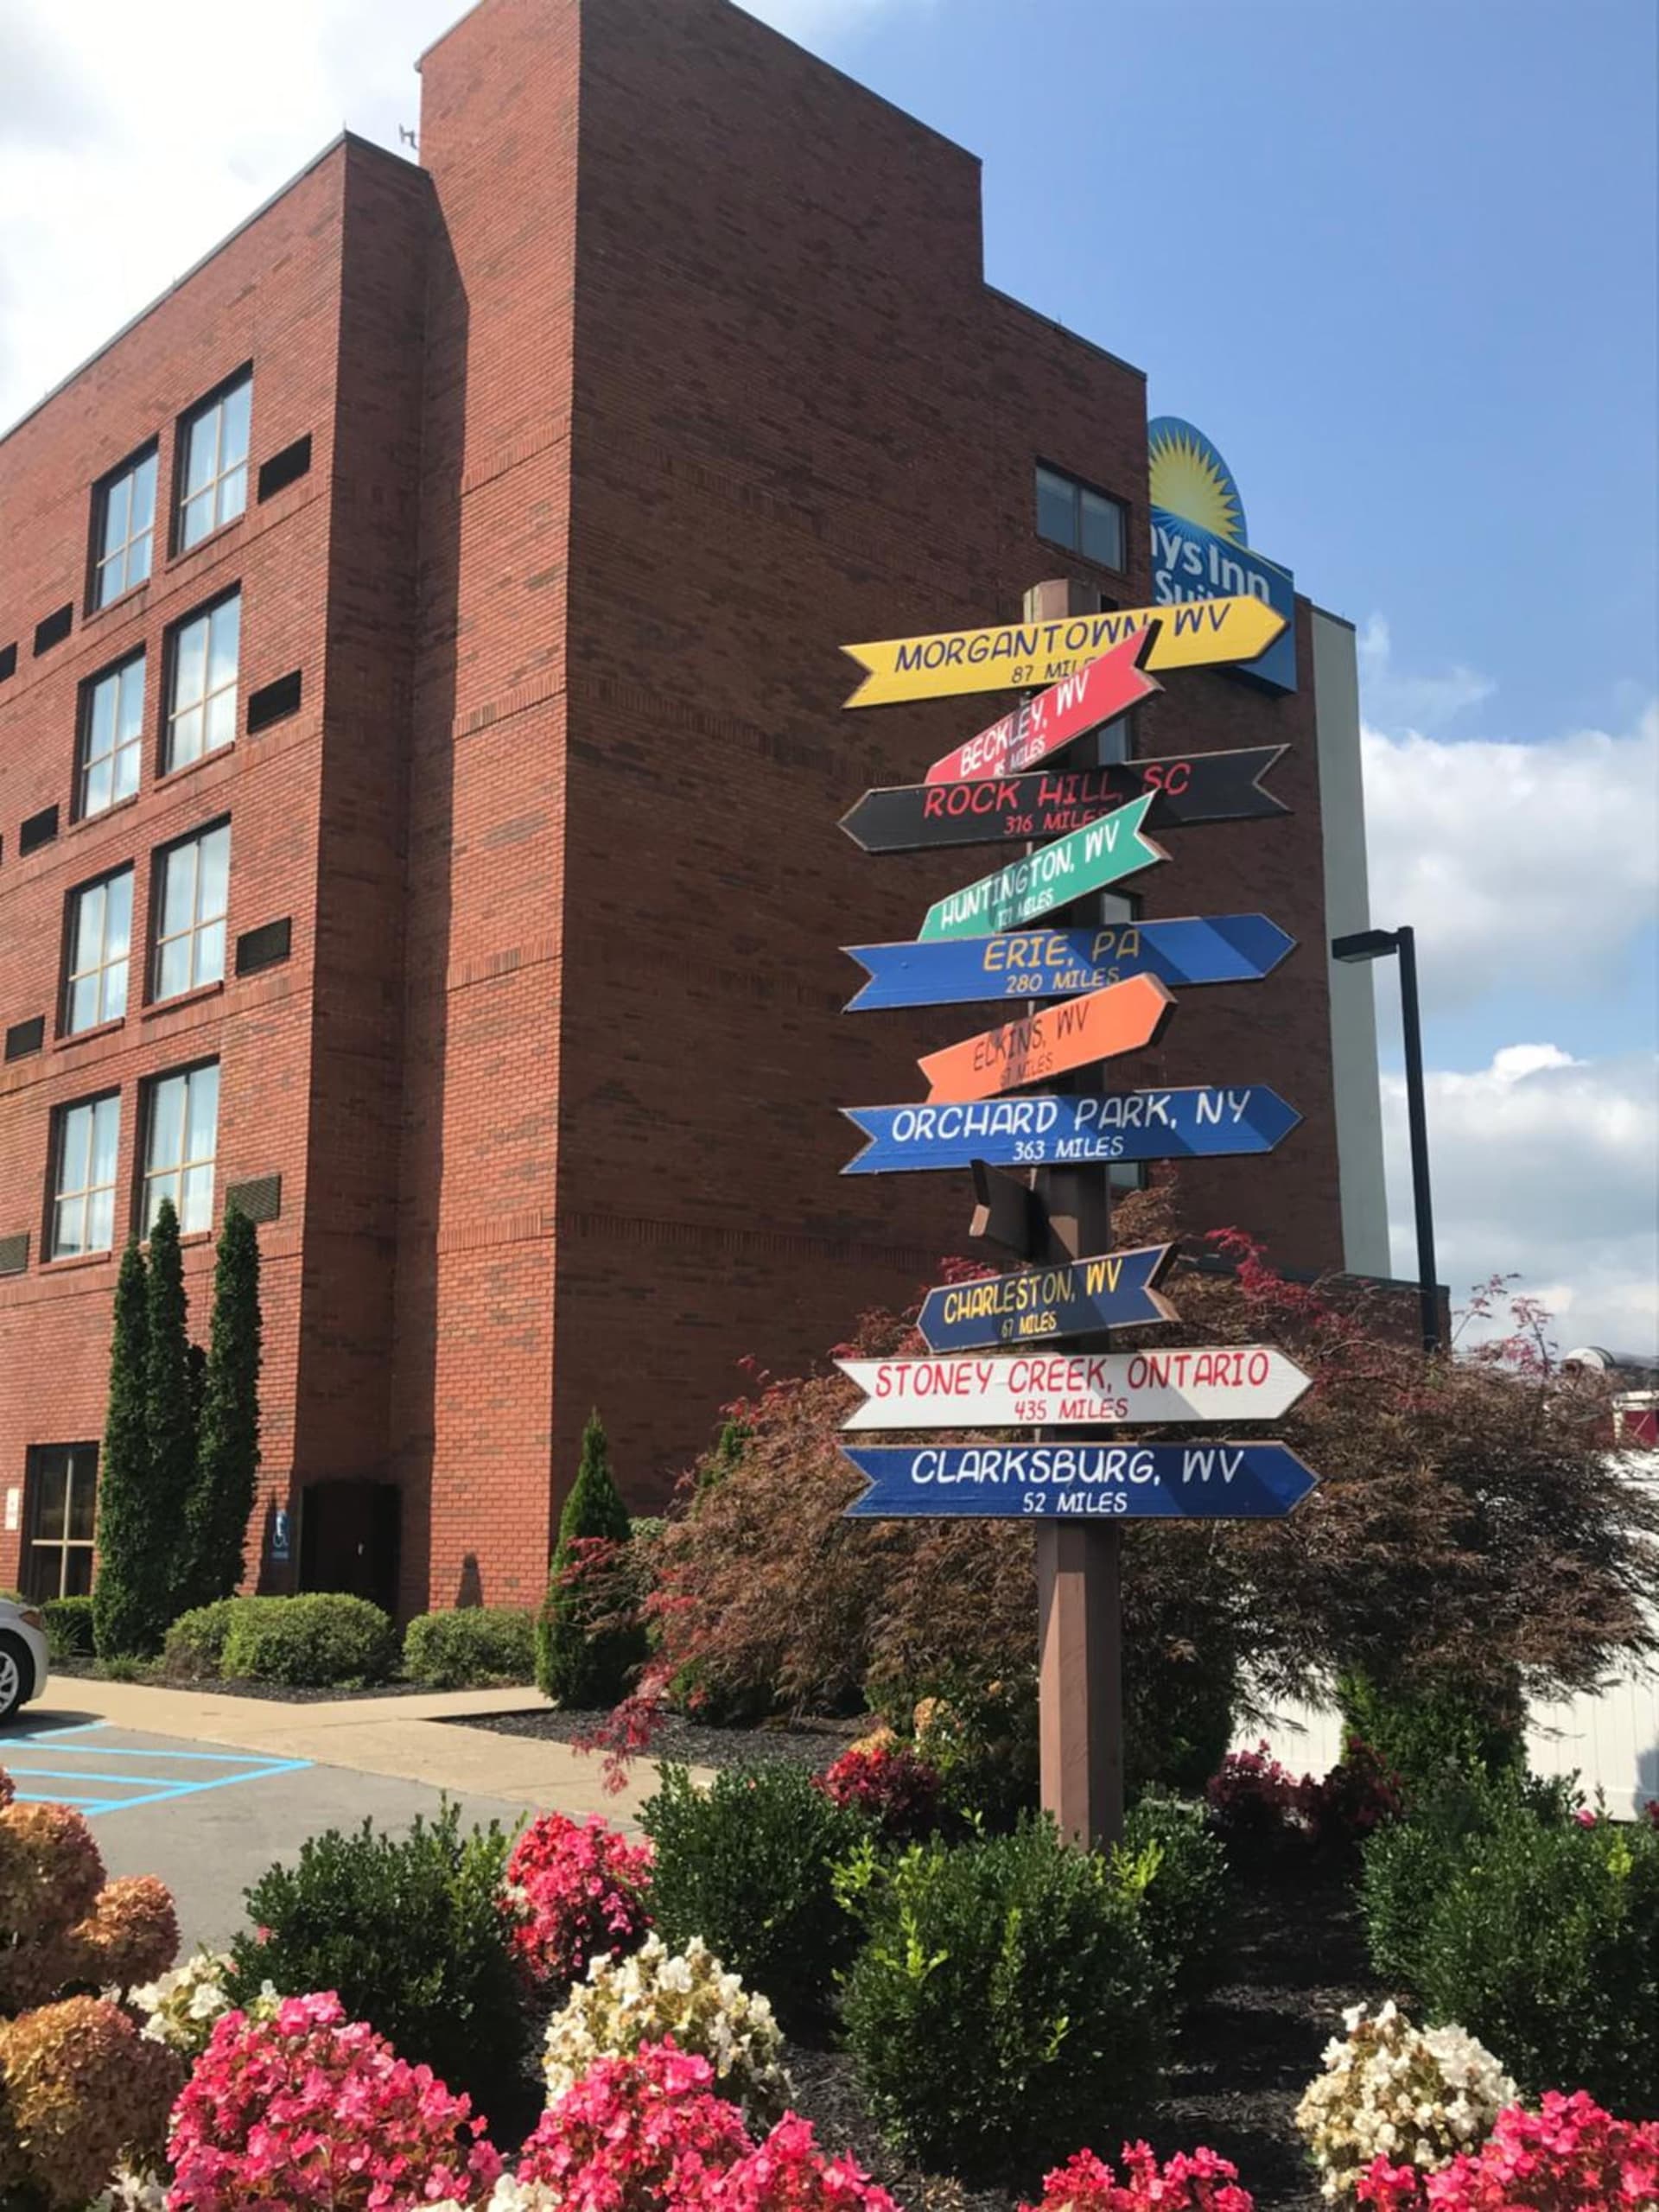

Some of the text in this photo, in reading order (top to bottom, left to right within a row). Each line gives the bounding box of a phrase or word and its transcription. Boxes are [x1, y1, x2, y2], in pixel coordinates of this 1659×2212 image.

[1209, 543, 1270, 604] Inn
[1174, 602, 1231, 636] WV
[1011, 664, 1034, 683] 87
[960, 669, 1090, 778] BECKLEY, WV
[923, 779, 1020, 818] ROCK
[1141, 763, 1191, 796] SC
[941, 820, 1120, 930] HUNTINGTON, WV
[982, 931, 1140, 972] ERIE, PA
[1005, 968, 1121, 994] 280 MILES
[1057, 1001, 1090, 1039] WV
[892, 1090, 1251, 1142] ORCHARD PARK, NY
[1013, 1135, 1124, 1161] 363 MILES
[944, 1258, 1122, 1324] CHARLESTON, WV
[1001, 1311, 1057, 1338] 67 MILES
[875, 1352, 1269, 1398] STONEY CREEK, ONTARIO
[1014, 1398, 1128, 1421] 435 MILES
[912, 1449, 1244, 1486] CLARKSBURG, WV
[1023, 1491, 1128, 1513] 52 MILES
